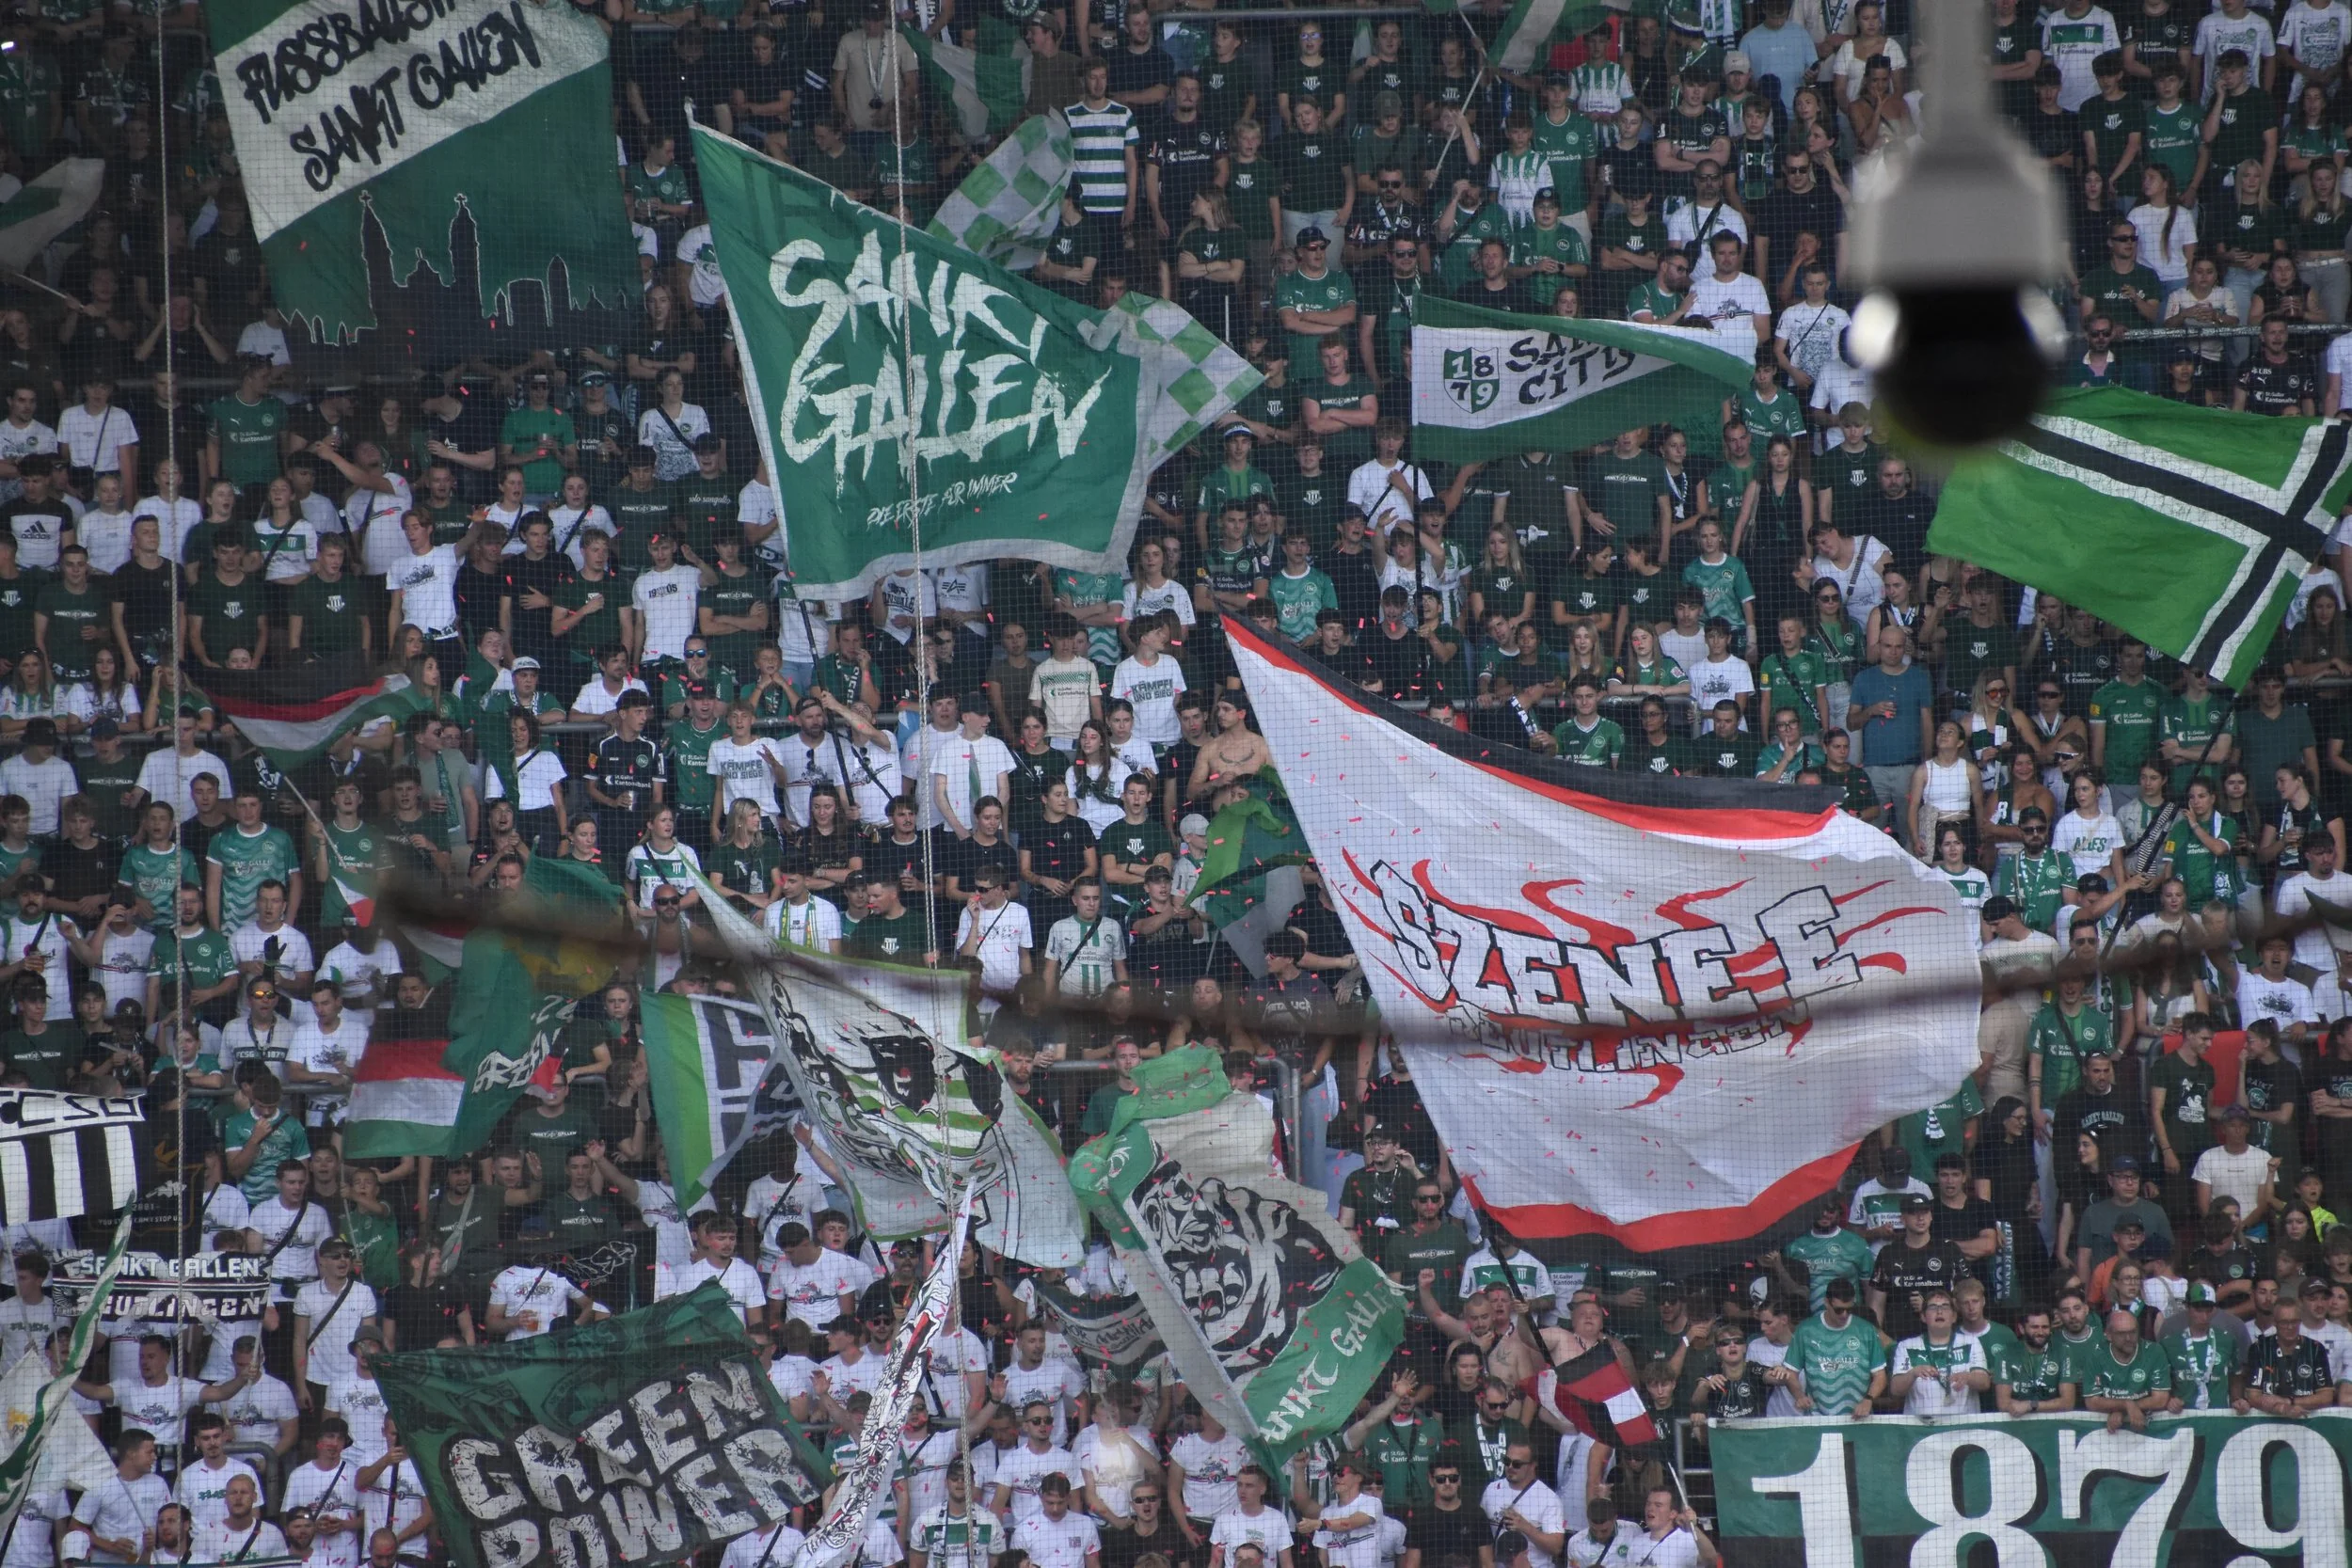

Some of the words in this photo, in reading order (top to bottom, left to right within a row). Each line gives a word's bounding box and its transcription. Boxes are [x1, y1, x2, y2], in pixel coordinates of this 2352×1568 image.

[290, 66, 405, 192] SANKT
[407, 0, 541, 110] GALLEN
[781, 344, 1112, 482] GALLEN
[866, 503, 894, 531] DIE
[967, 471, 1018, 500] IMMER
[721, 759, 763, 771] KÄMPFE
[168, 1258, 260, 1278] GALLEN
[450, 1360, 765, 1524] GREEN
[480, 1427, 821, 1568] POWER
[1751, 1420, 2349, 1568] 1879
